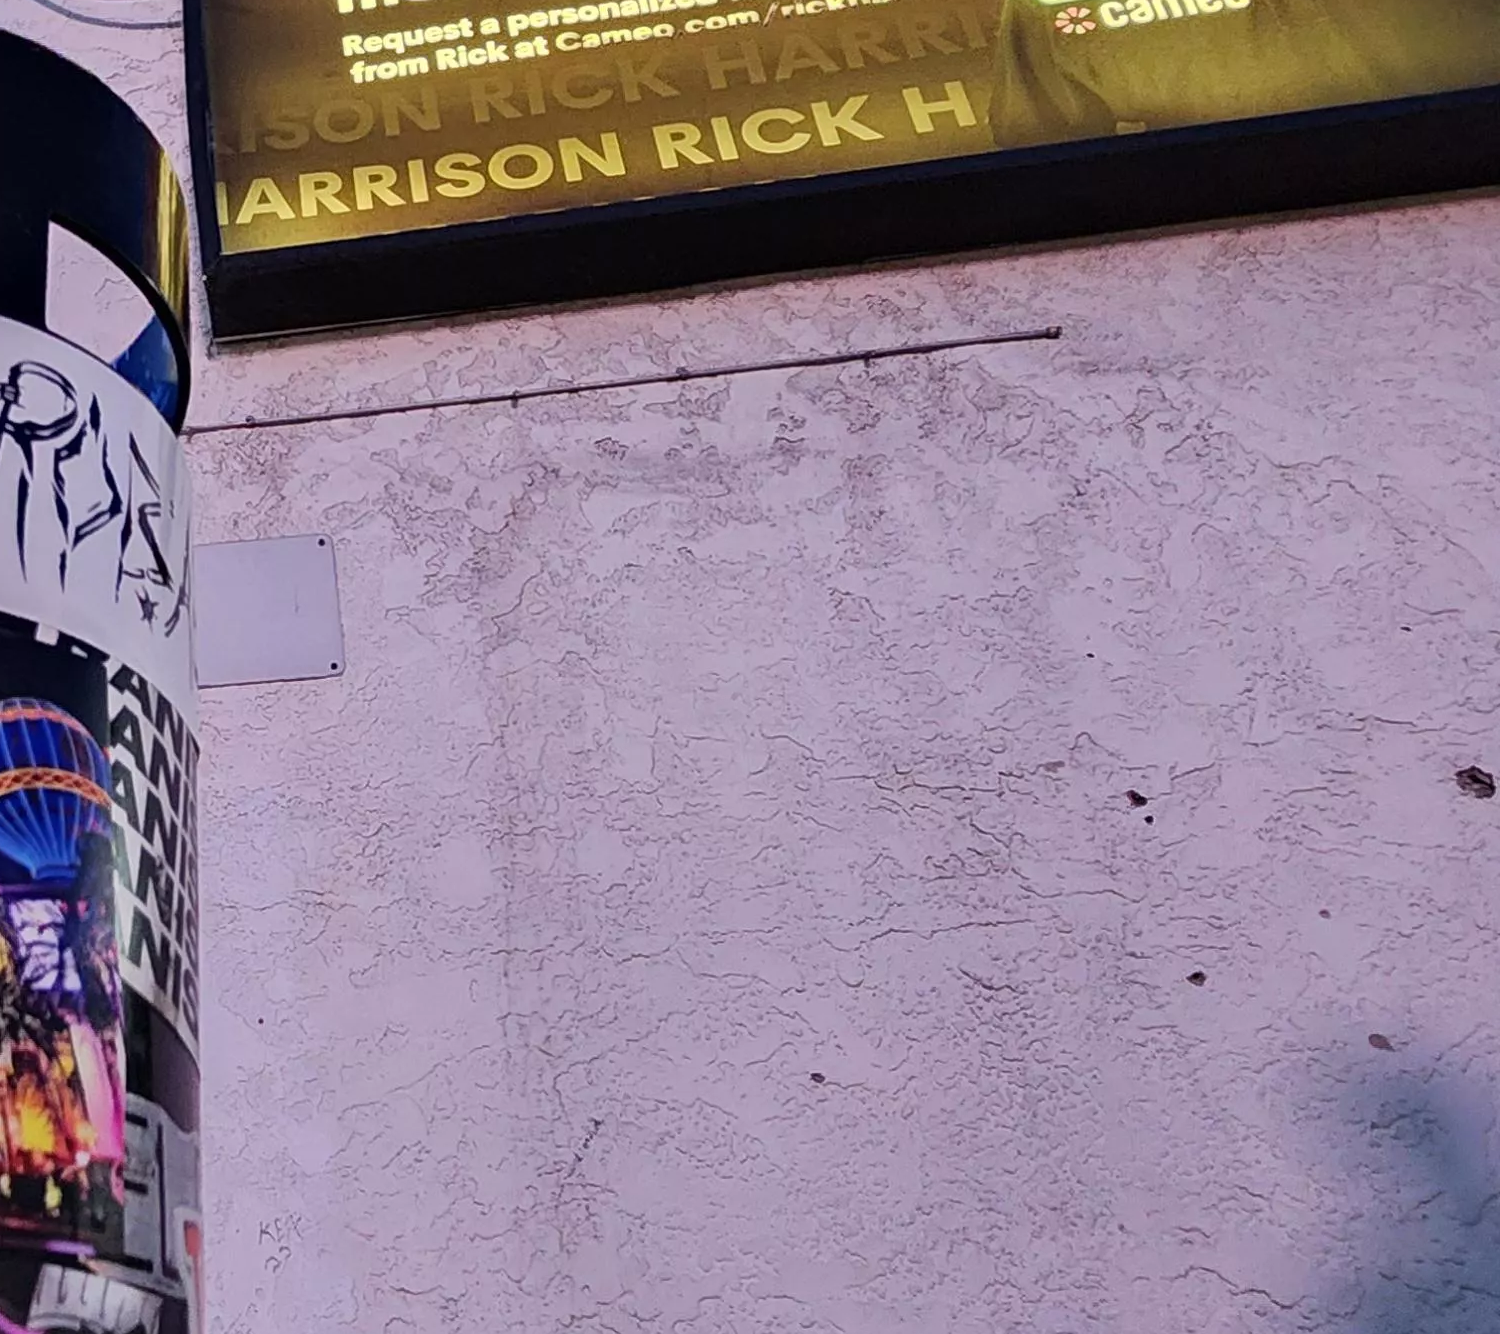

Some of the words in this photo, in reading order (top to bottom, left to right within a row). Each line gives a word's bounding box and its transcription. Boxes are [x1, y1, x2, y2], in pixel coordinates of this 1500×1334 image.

[342, 17, 474, 56] Request
[480, 17, 501, 35] a
[350, 59, 429, 84] from
[435, 41, 510, 71] Rick
[514, 35, 550, 59] at
[652, 94, 885, 170] RICK
